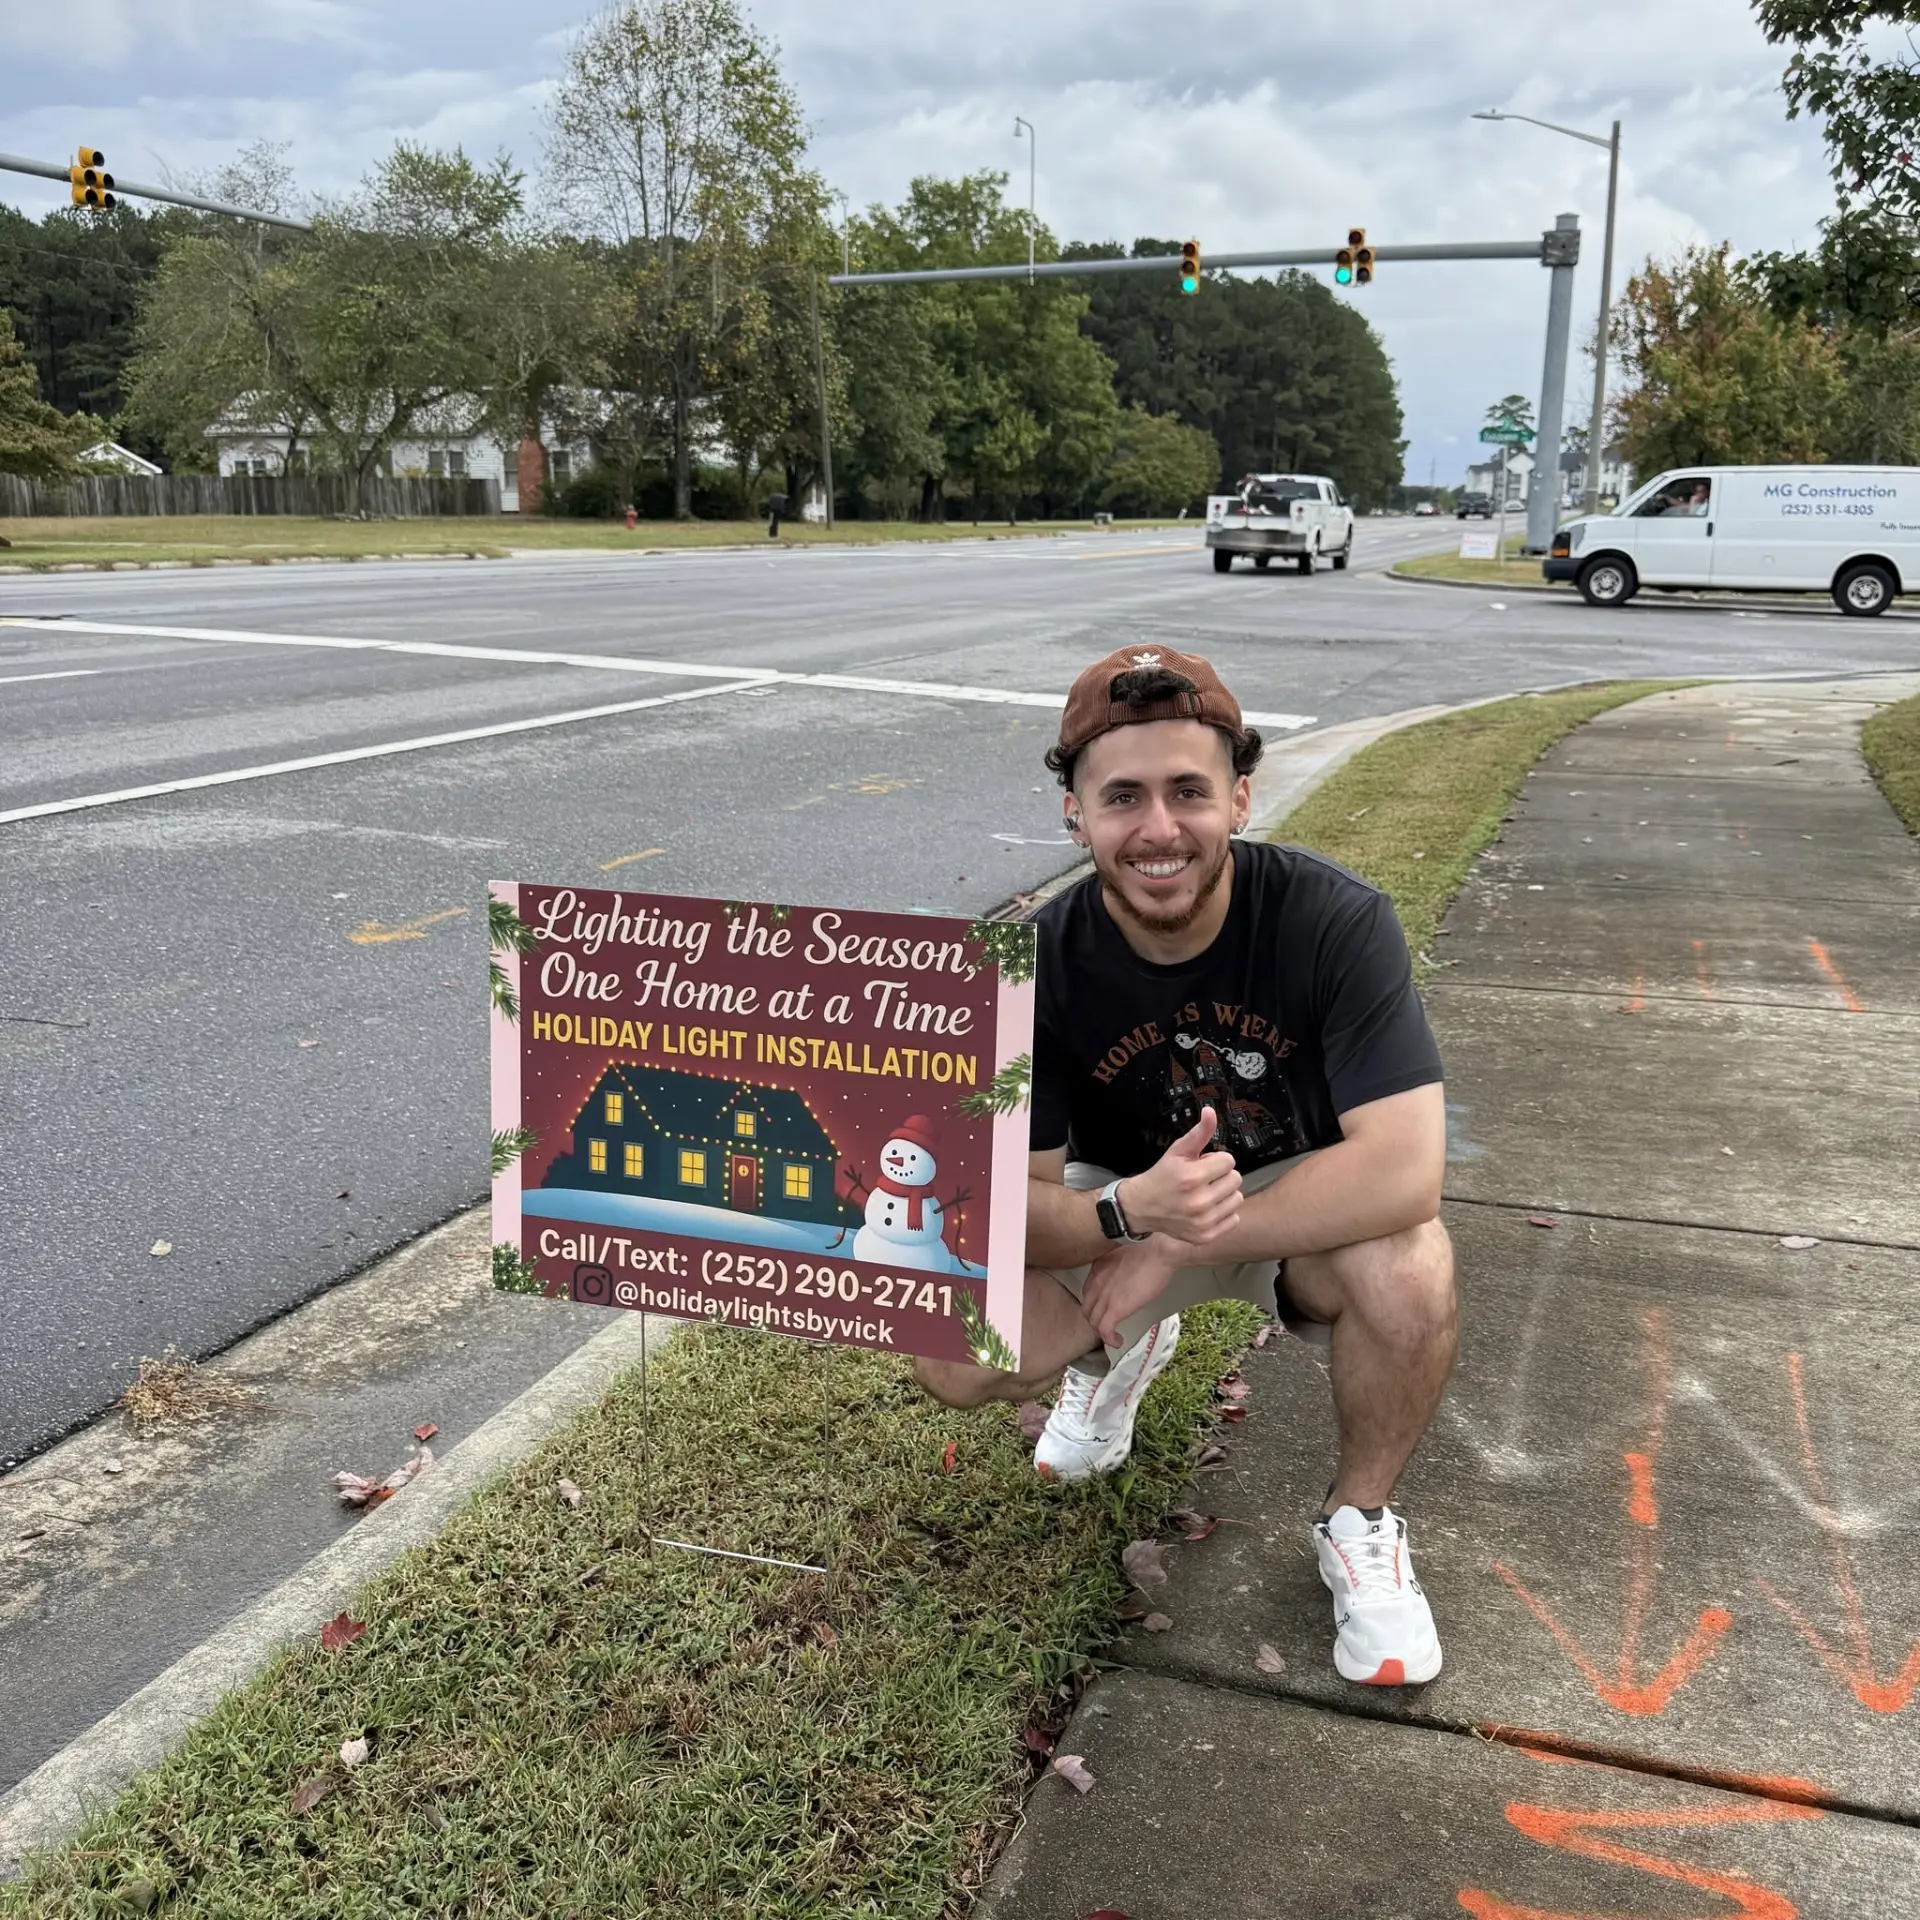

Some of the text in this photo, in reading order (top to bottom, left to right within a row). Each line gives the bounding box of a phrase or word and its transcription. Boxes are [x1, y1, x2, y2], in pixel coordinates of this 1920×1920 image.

[1763, 483, 1897, 498] MG Construction
[1781, 504, 1874, 516] (252) 531-4305
[533, 889, 978, 982] Lighting the Season,
[540, 951, 975, 1036] One Home at a Time
[533, 1012, 977, 1086] HOLIDAY LIGHT INSTALLATION
[1091, 1020, 1167, 1085] HOME
[1172, 1001, 1200, 1027] IS
[539, 1227, 953, 1317] Call/Text: (252) 290-2741
[614, 1279, 895, 1346] @holidaylightsbyvick
